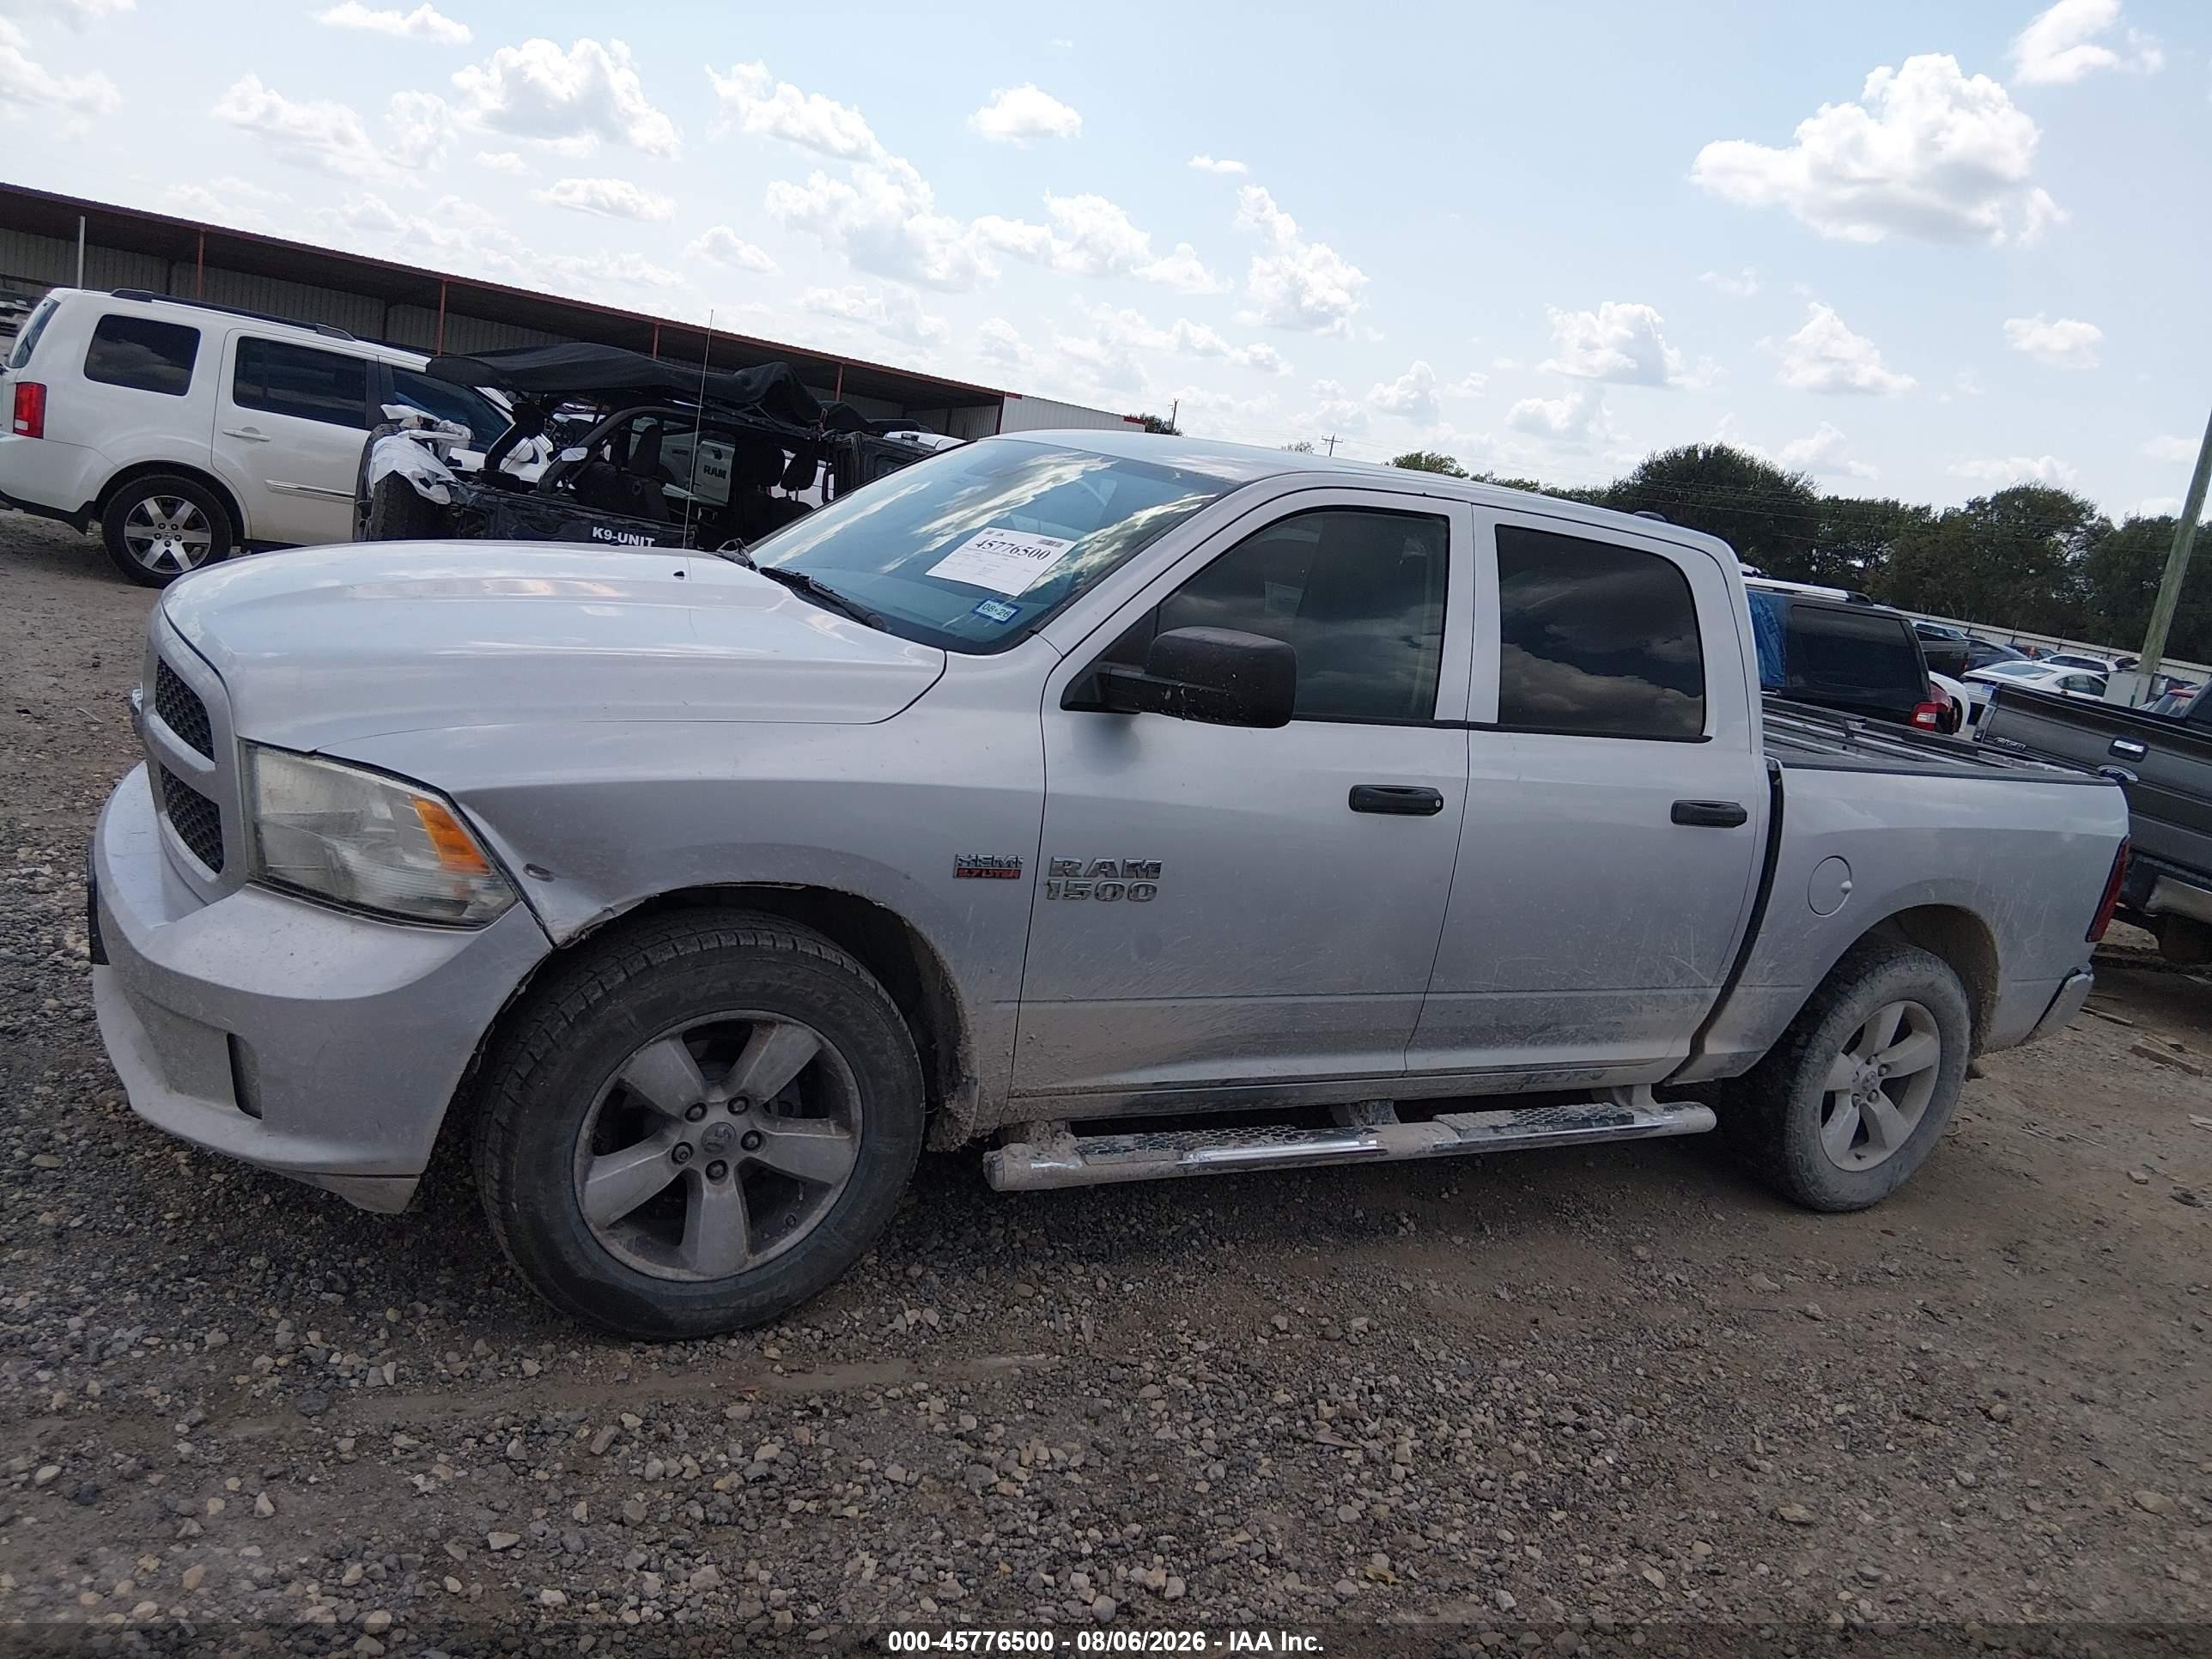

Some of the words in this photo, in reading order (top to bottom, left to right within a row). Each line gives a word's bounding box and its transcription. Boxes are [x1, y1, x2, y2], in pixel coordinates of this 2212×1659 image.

[592, 526, 655, 547] K9-UNIT
[975, 538, 1051, 560] 45776500
[1048, 857, 1162, 879] RAM
[1044, 879, 1158, 902] 1500
